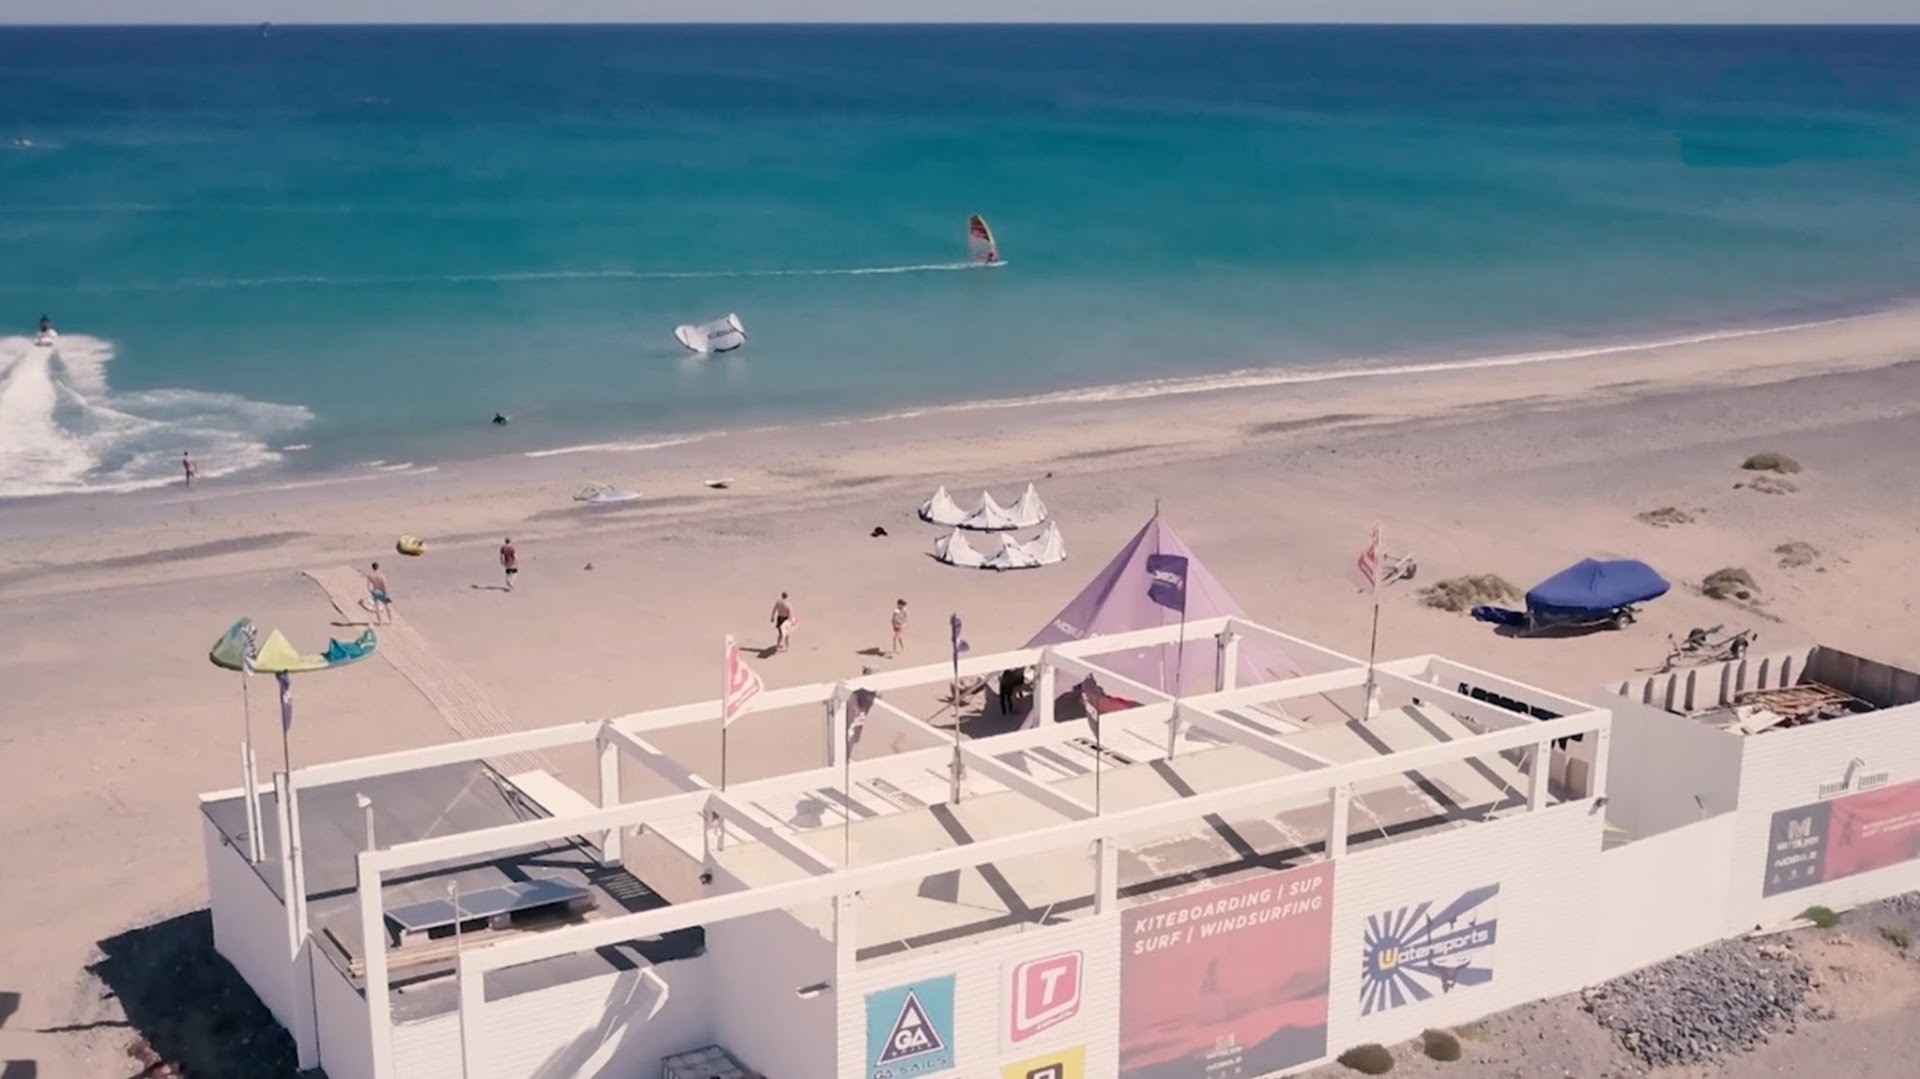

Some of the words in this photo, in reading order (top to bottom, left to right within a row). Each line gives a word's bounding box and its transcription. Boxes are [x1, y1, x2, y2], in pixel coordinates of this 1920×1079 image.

[1133, 931, 1183, 955] SURF
[1200, 896, 1323, 938] WINDSURFING
[1134, 888, 1272, 934] KITEBOARDING
[1289, 876, 1323, 896] SUP
[1040, 966, 1067, 1006] T
[894, 1026, 930, 1051] GA
